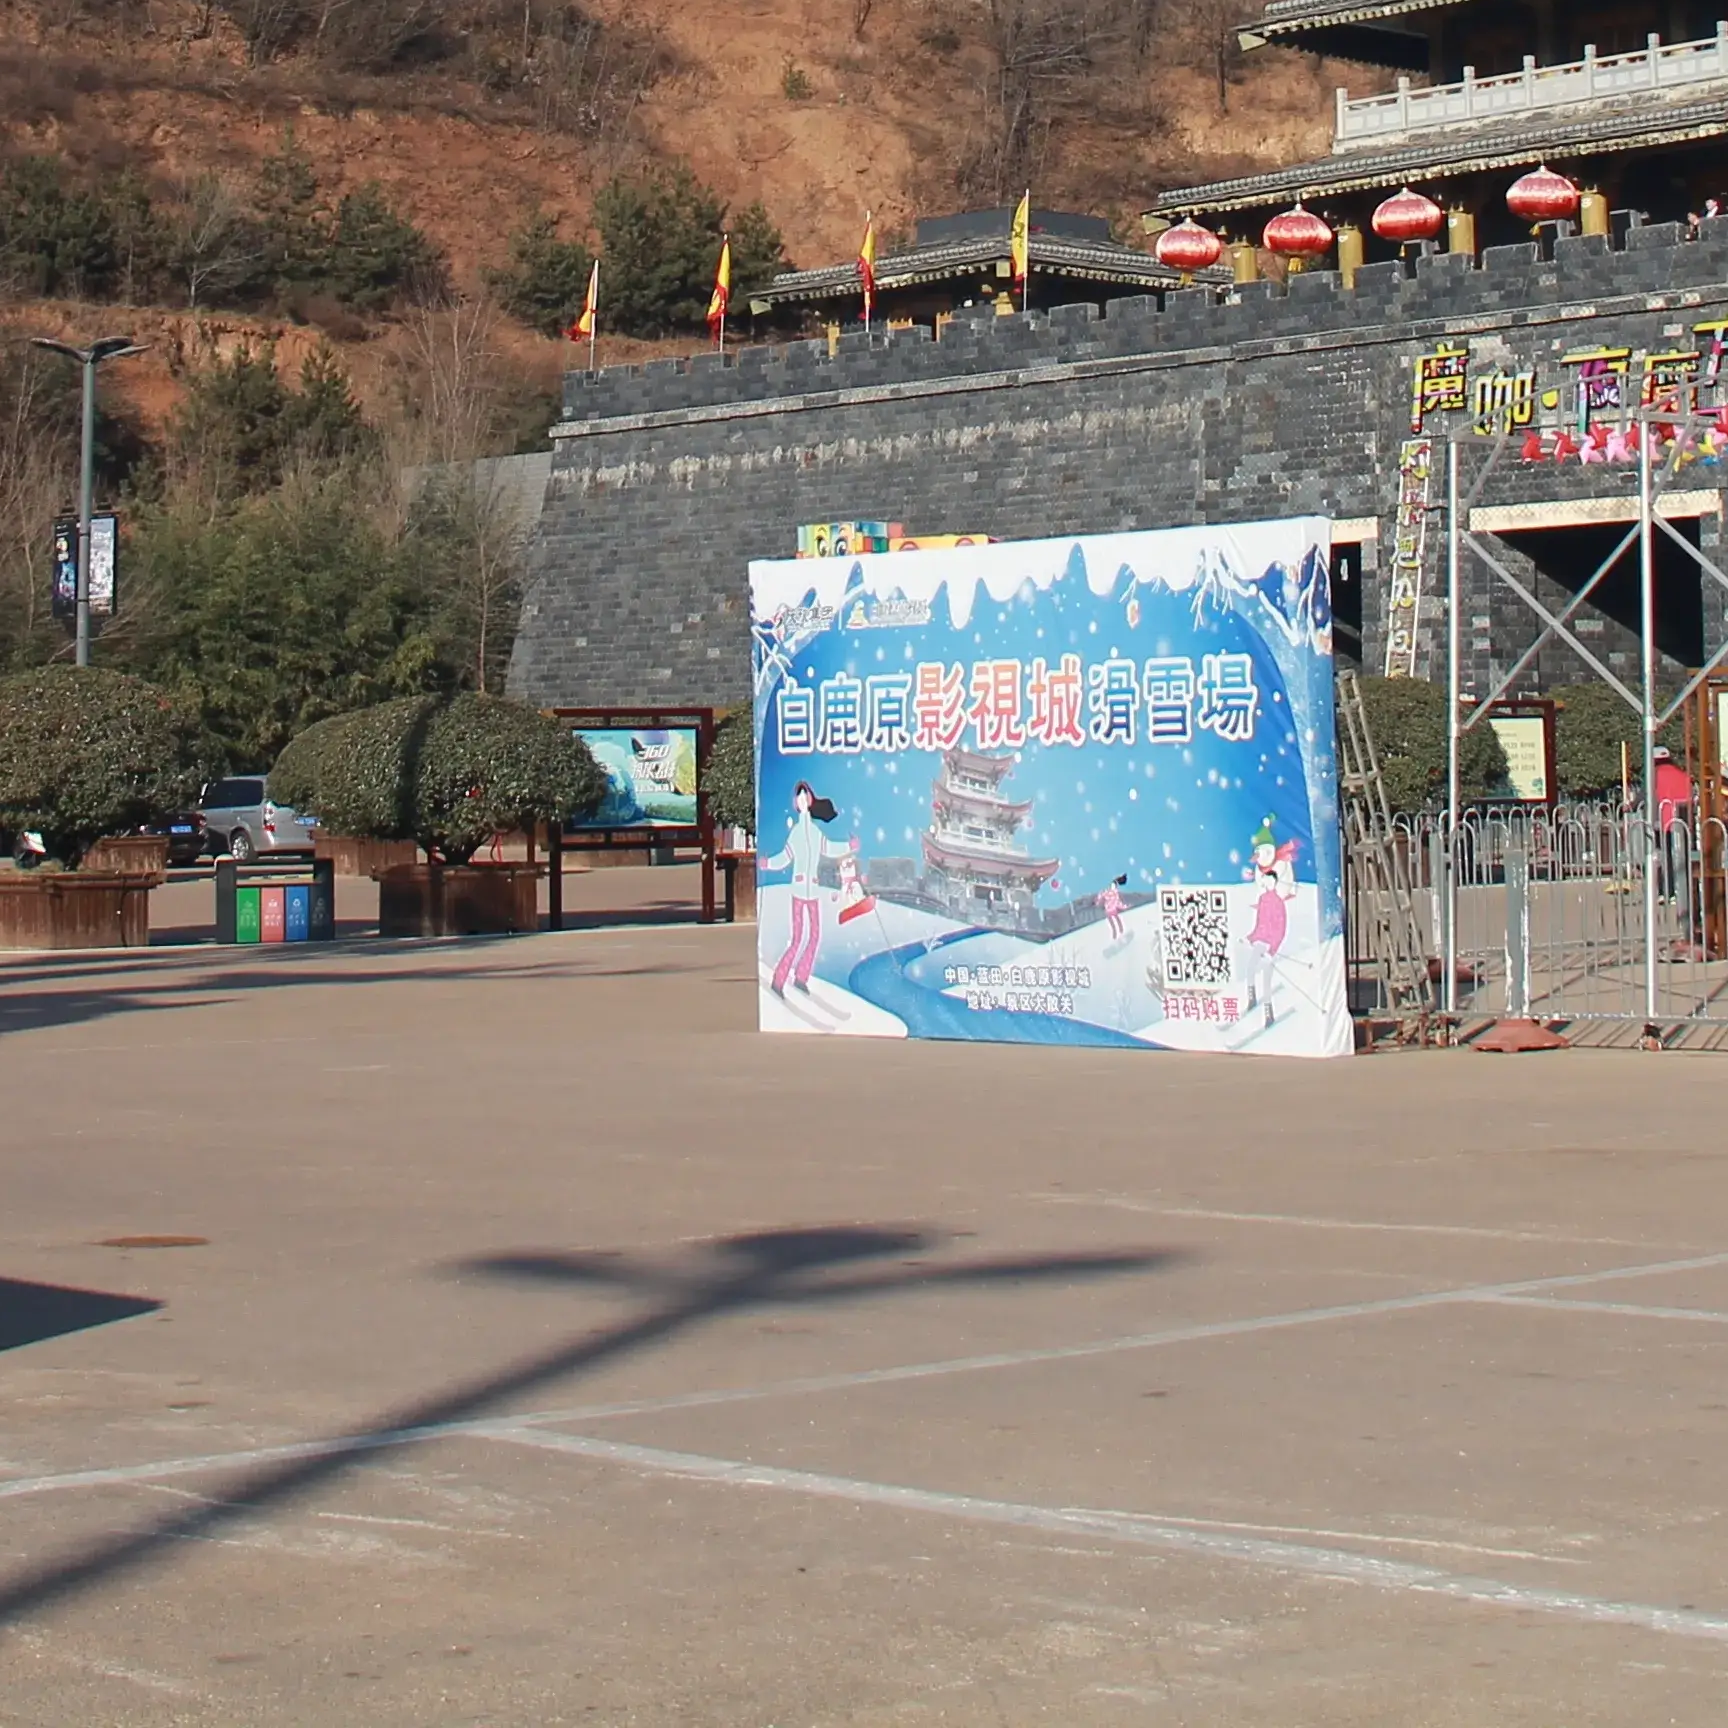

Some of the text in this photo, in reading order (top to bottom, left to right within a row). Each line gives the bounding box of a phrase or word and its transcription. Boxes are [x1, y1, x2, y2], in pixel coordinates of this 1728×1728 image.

[775, 652, 1259, 755] 白鹿原影視城滑雪場
[1163, 996, 1240, 1022] 扫码购票
